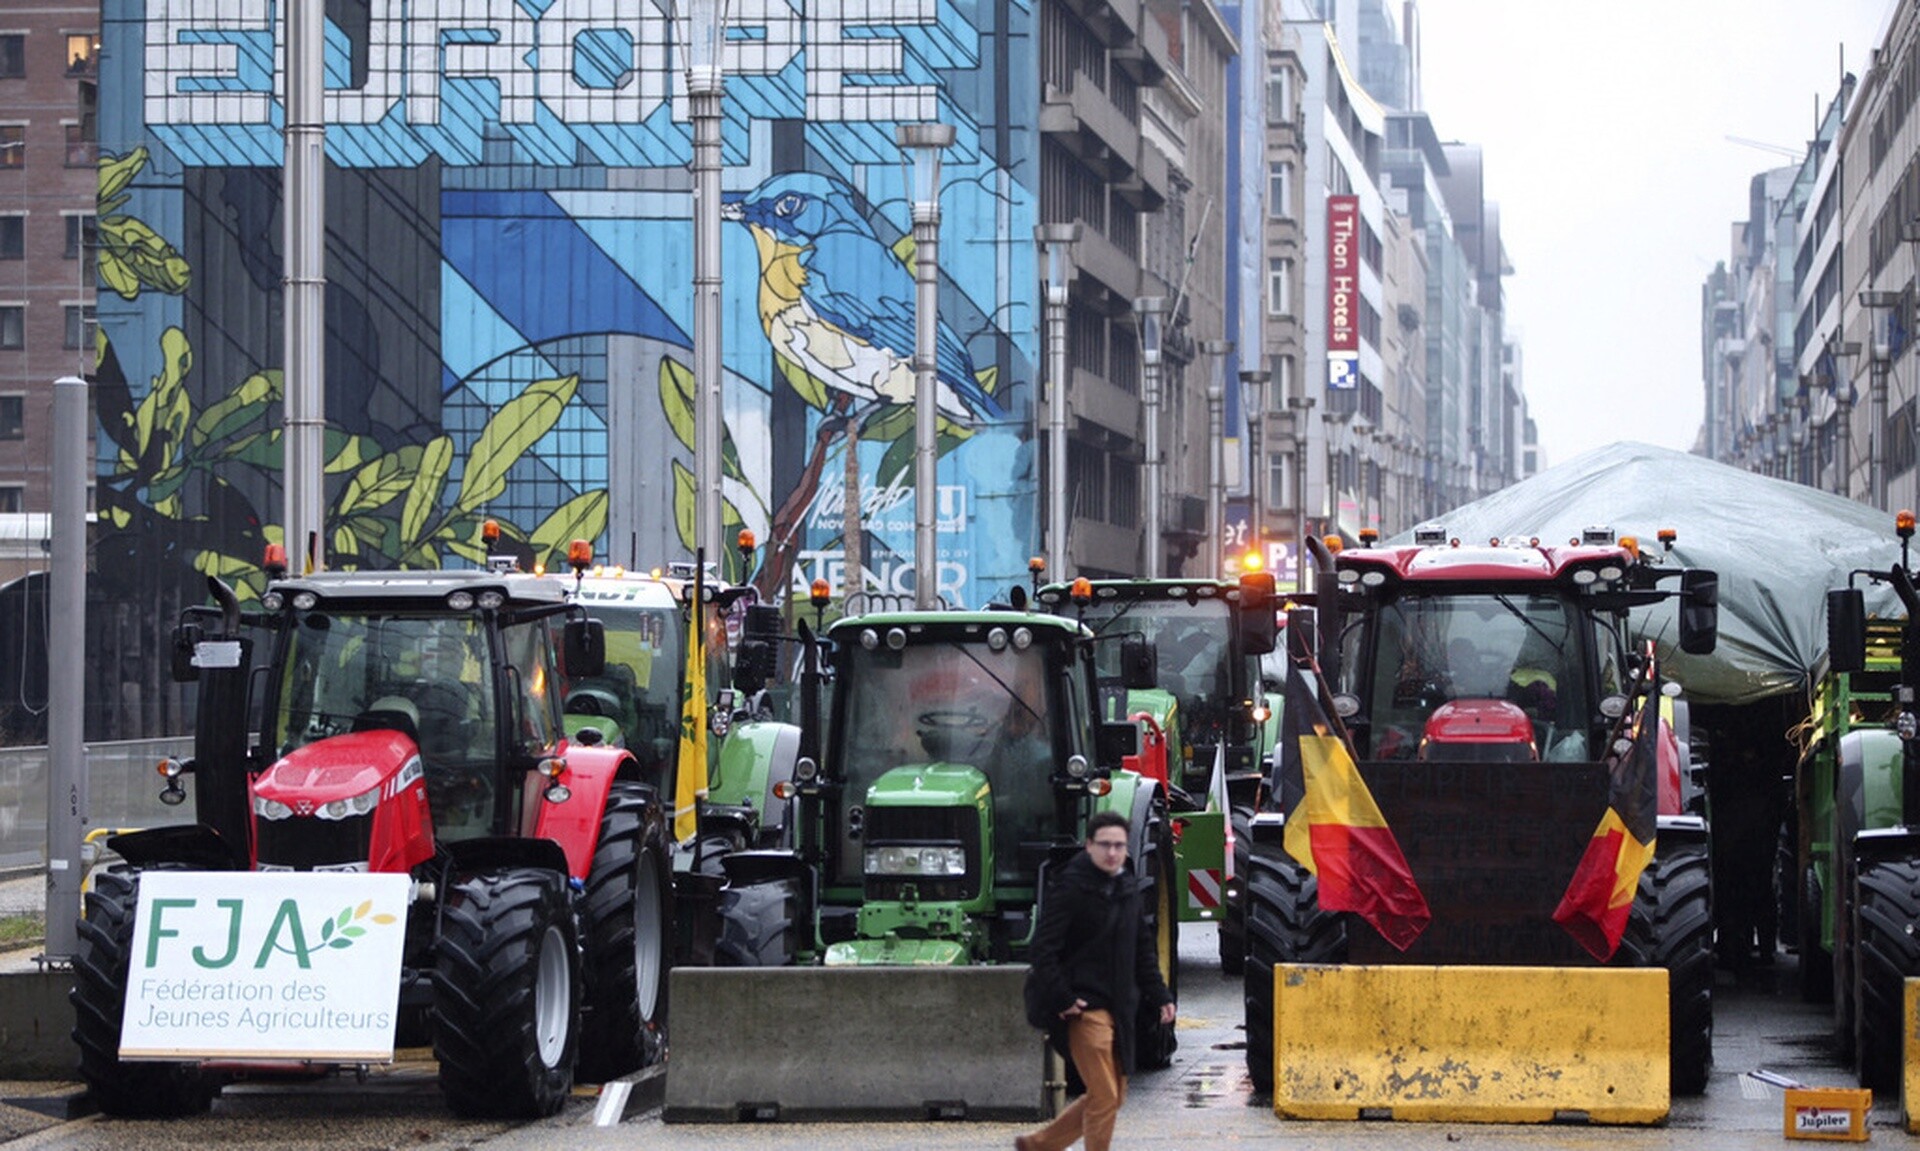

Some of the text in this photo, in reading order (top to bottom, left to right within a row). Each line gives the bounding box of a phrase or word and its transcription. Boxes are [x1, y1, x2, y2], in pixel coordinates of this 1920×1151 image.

[145, 0, 940, 126] EUROPE
[1333, 216, 1353, 342] Thon Hotels
[778, 549, 968, 608] ATENOR
[145, 899, 312, 970] FJA
[138, 1006, 390, 1034] Jeunes Agriculteurs
[140, 979, 327, 1002] Fédération des
[1801, 1115, 1846, 1128] Jupiler
